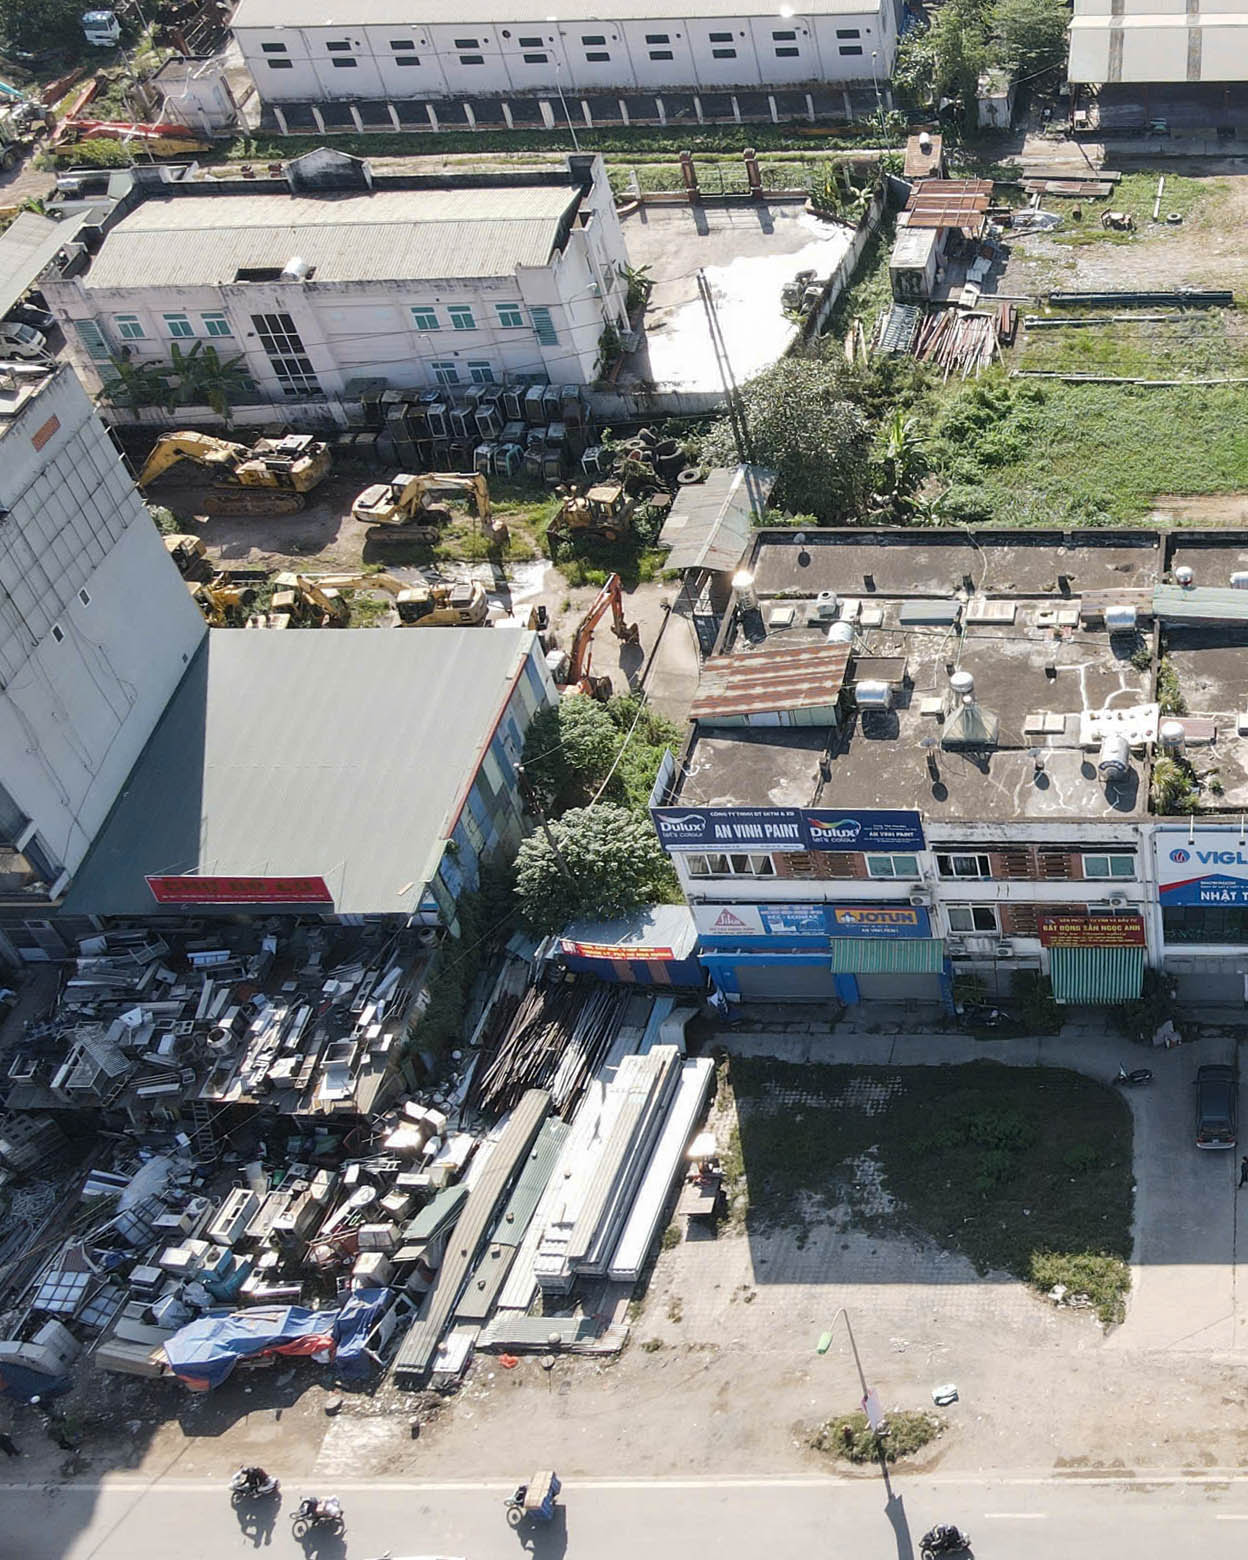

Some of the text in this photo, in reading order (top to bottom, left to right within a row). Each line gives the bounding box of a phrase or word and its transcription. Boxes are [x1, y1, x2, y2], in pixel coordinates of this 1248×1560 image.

[660, 822, 702, 832] Dulux
[714, 823, 800, 838] AN VINH PAINT
[809, 827, 856, 837] Dulux
[1200, 889, 1237, 903] NHẬT
[858, 912, 915, 923] JOTUN
